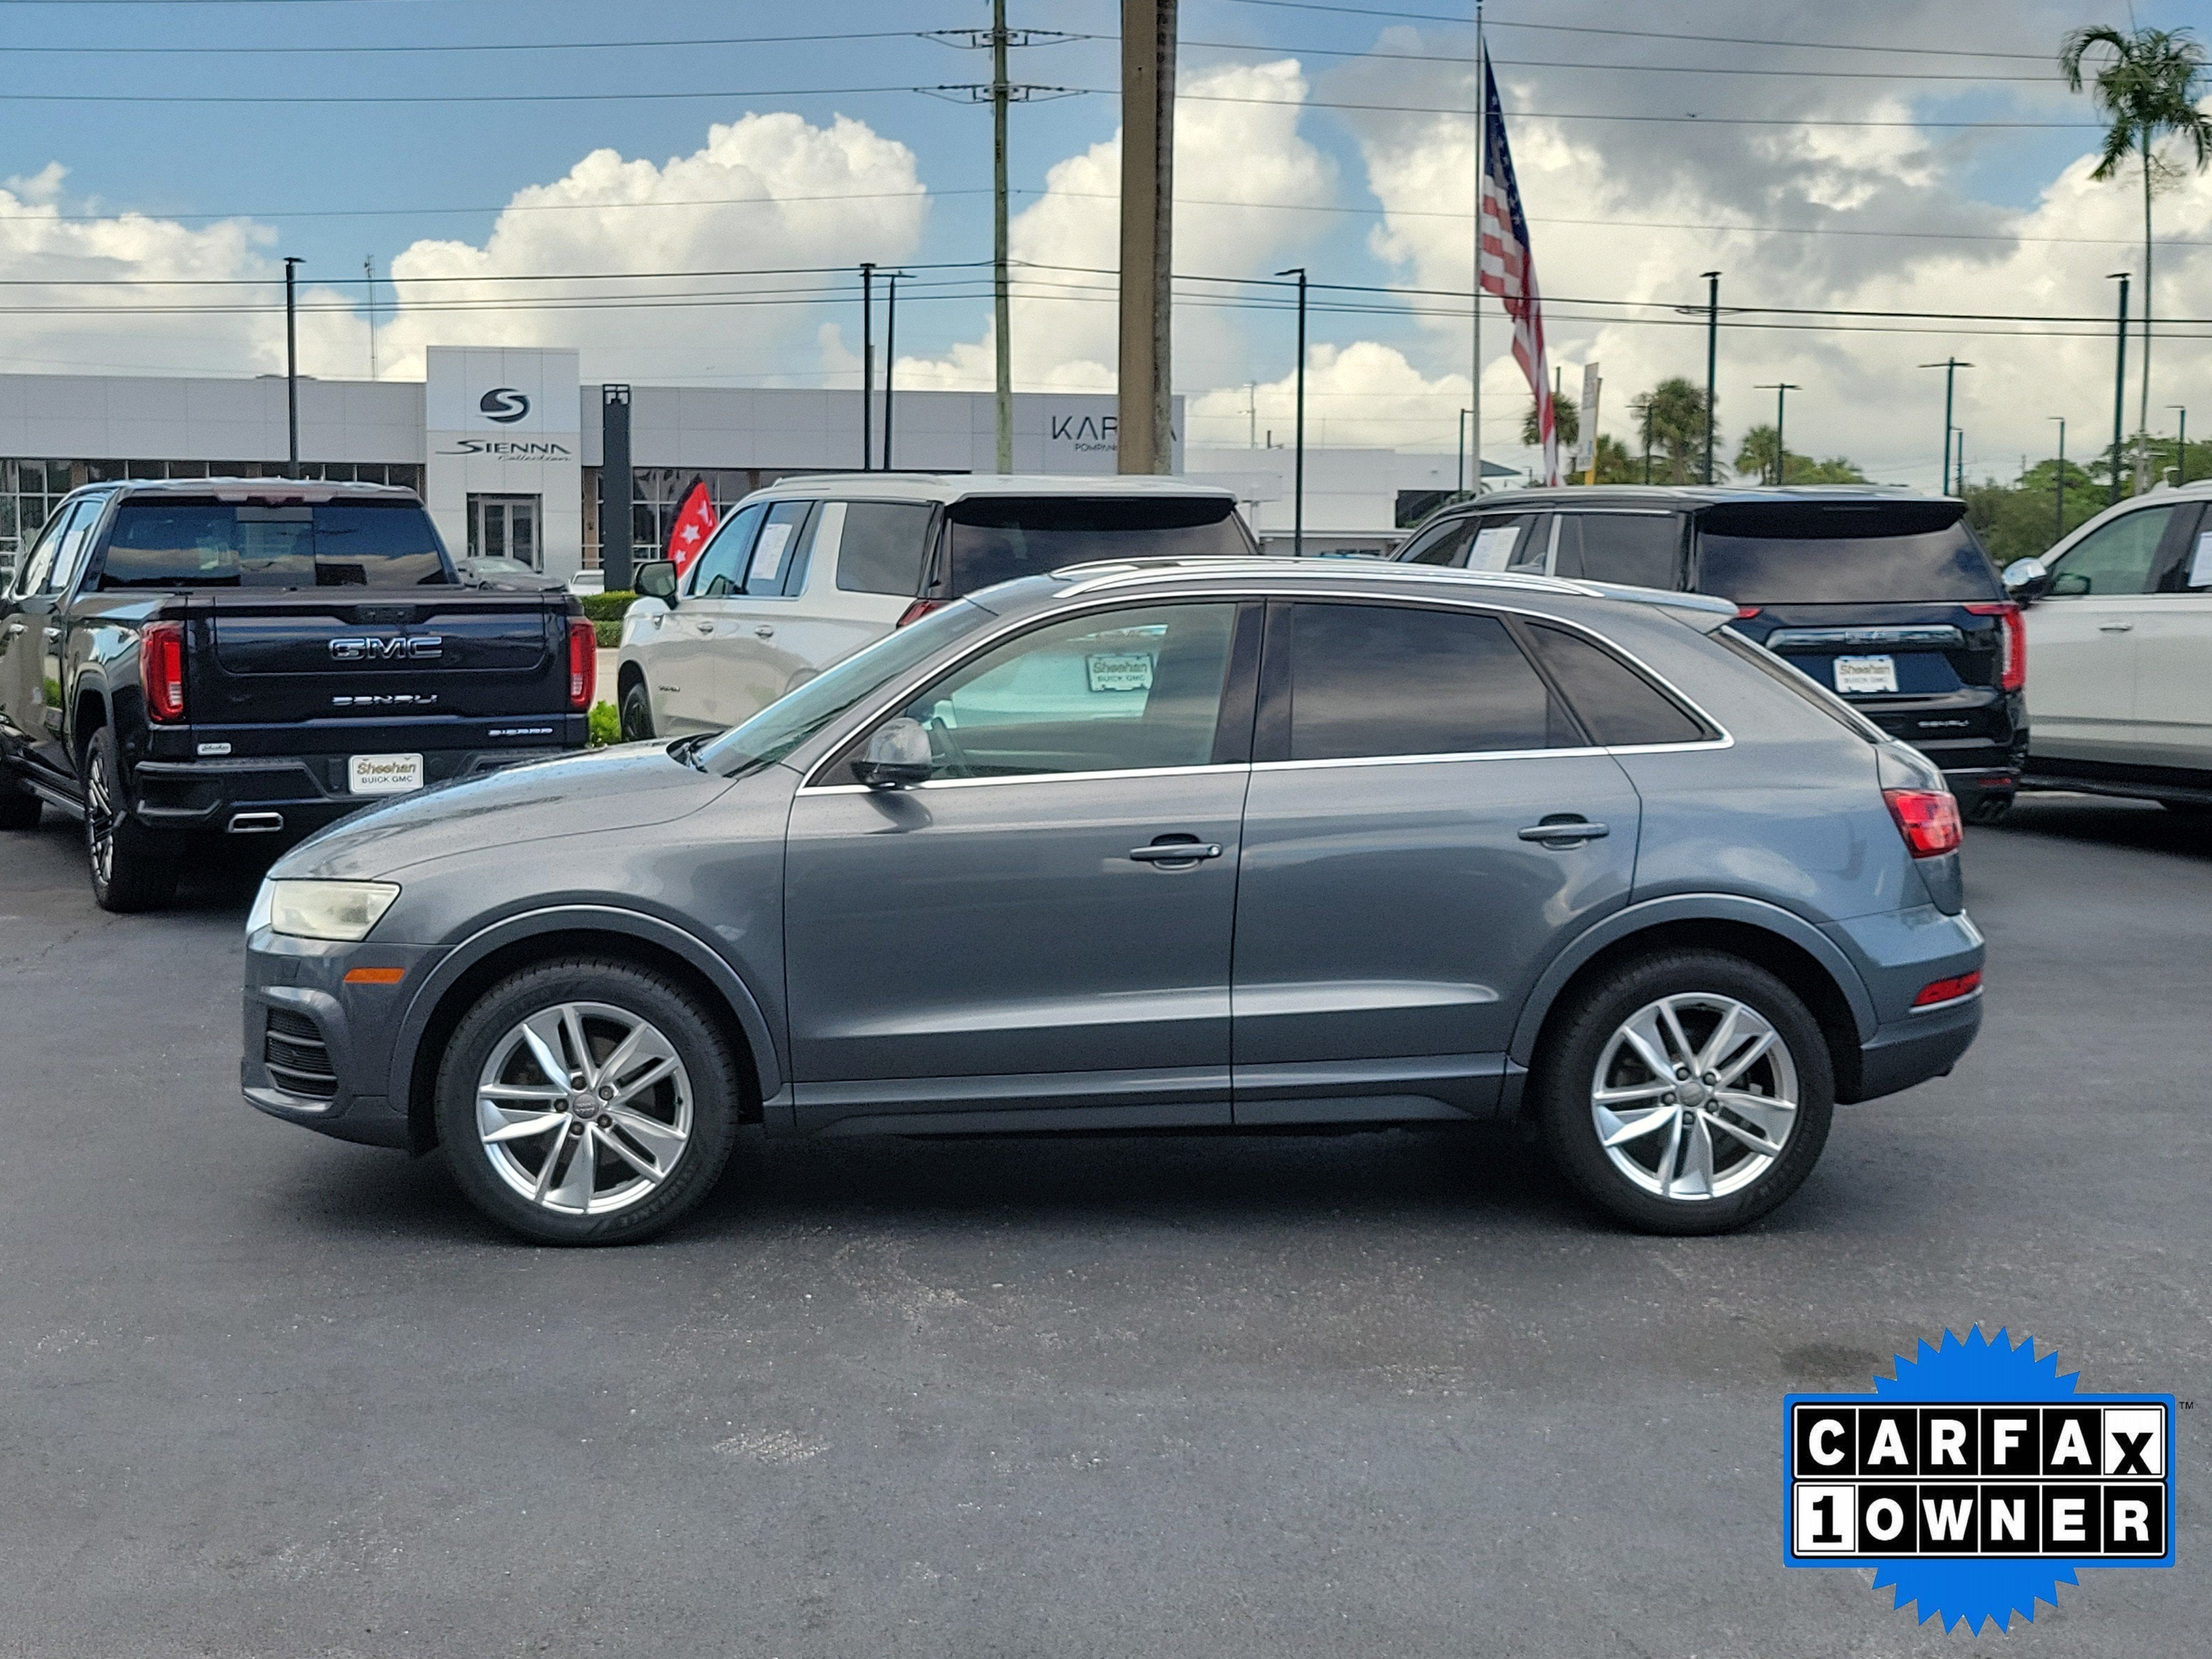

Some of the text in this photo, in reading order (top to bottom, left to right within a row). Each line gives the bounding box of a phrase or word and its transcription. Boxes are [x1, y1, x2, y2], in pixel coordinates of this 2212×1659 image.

[436, 439, 572, 455] SIENNA
[329, 636, 442, 661] GMC
[357, 761, 416, 775] Sheehan
